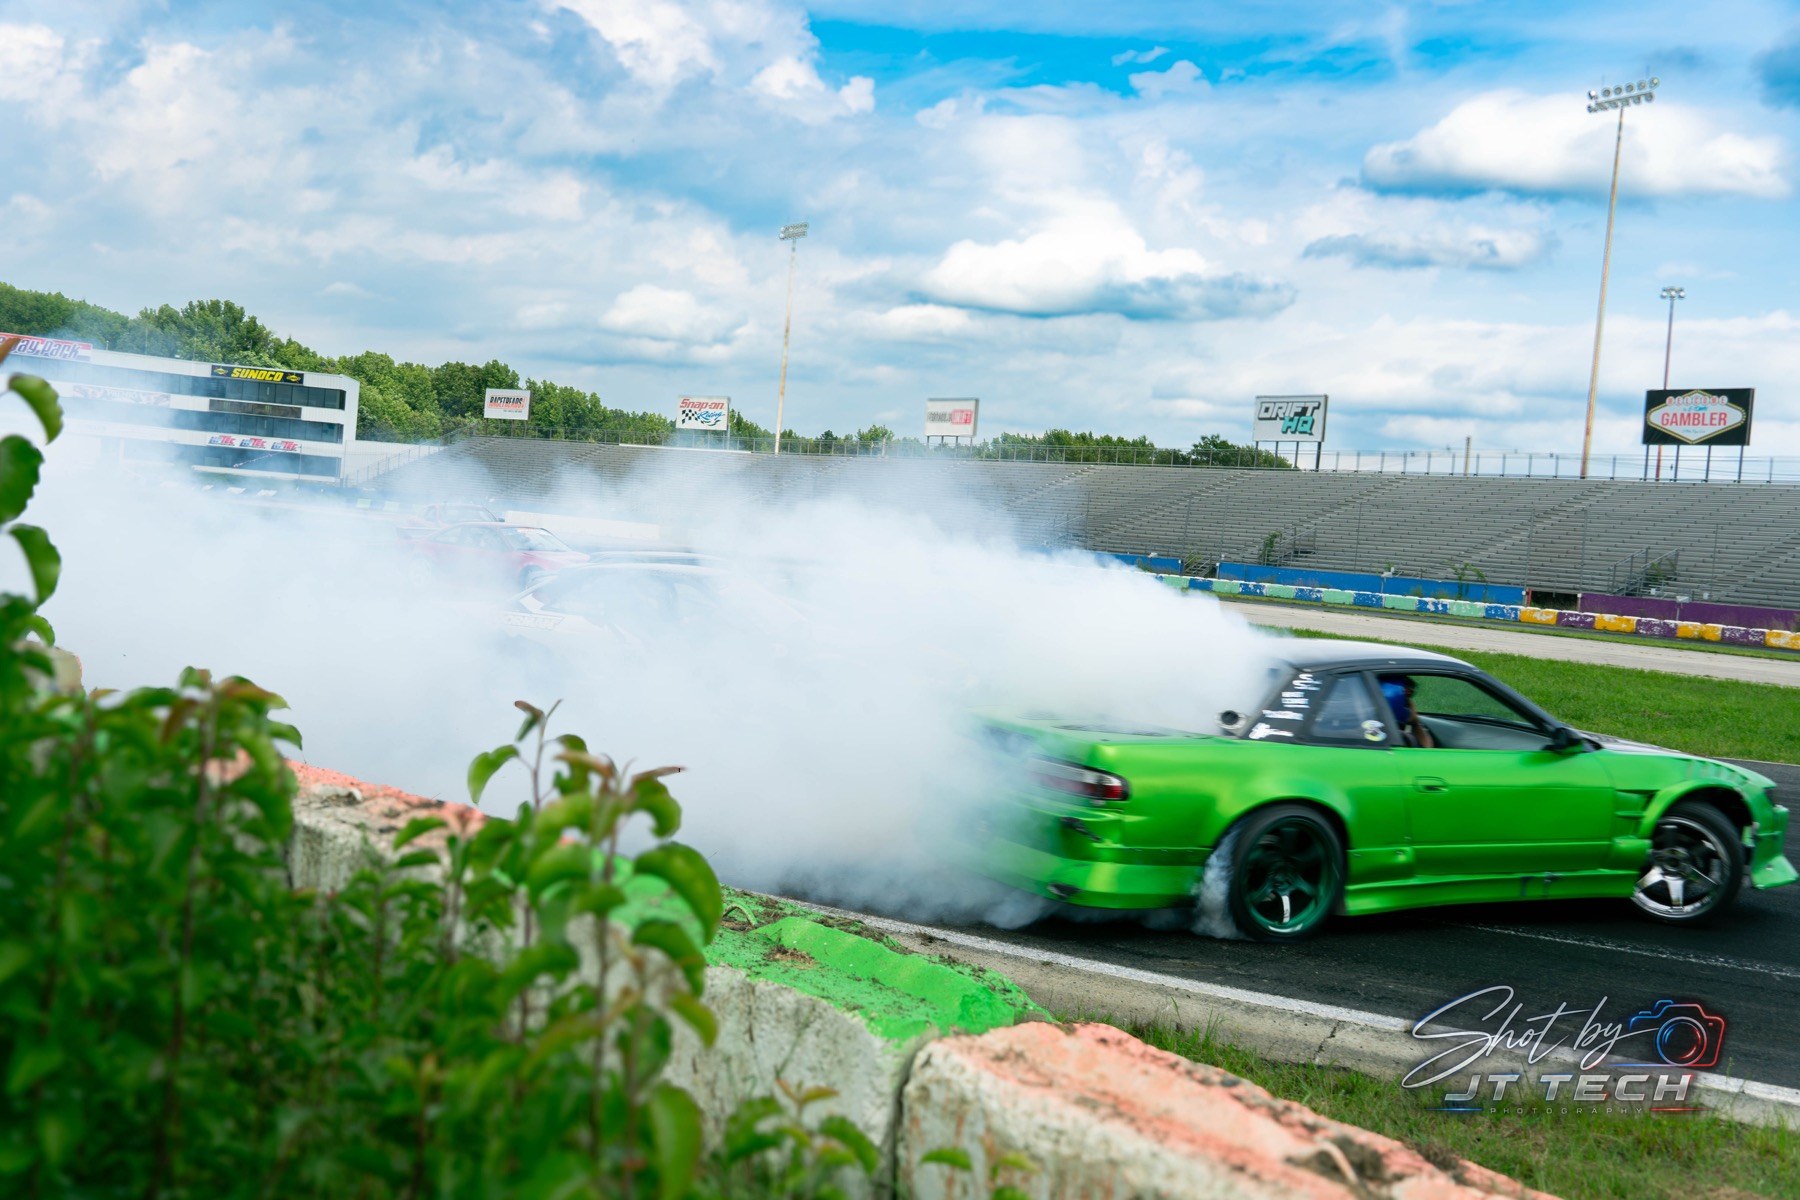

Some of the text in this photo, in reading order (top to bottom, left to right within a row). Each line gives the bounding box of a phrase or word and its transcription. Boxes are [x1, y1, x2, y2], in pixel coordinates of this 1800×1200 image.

[41, 340, 80, 359] Park
[231, 367, 284, 383] SUNOCO
[680, 398, 724, 411] Snap-on
[1258, 401, 1321, 420] DRIFT
[1281, 415, 1314, 436] HQ
[1661, 412, 1727, 426] GAMBLER
